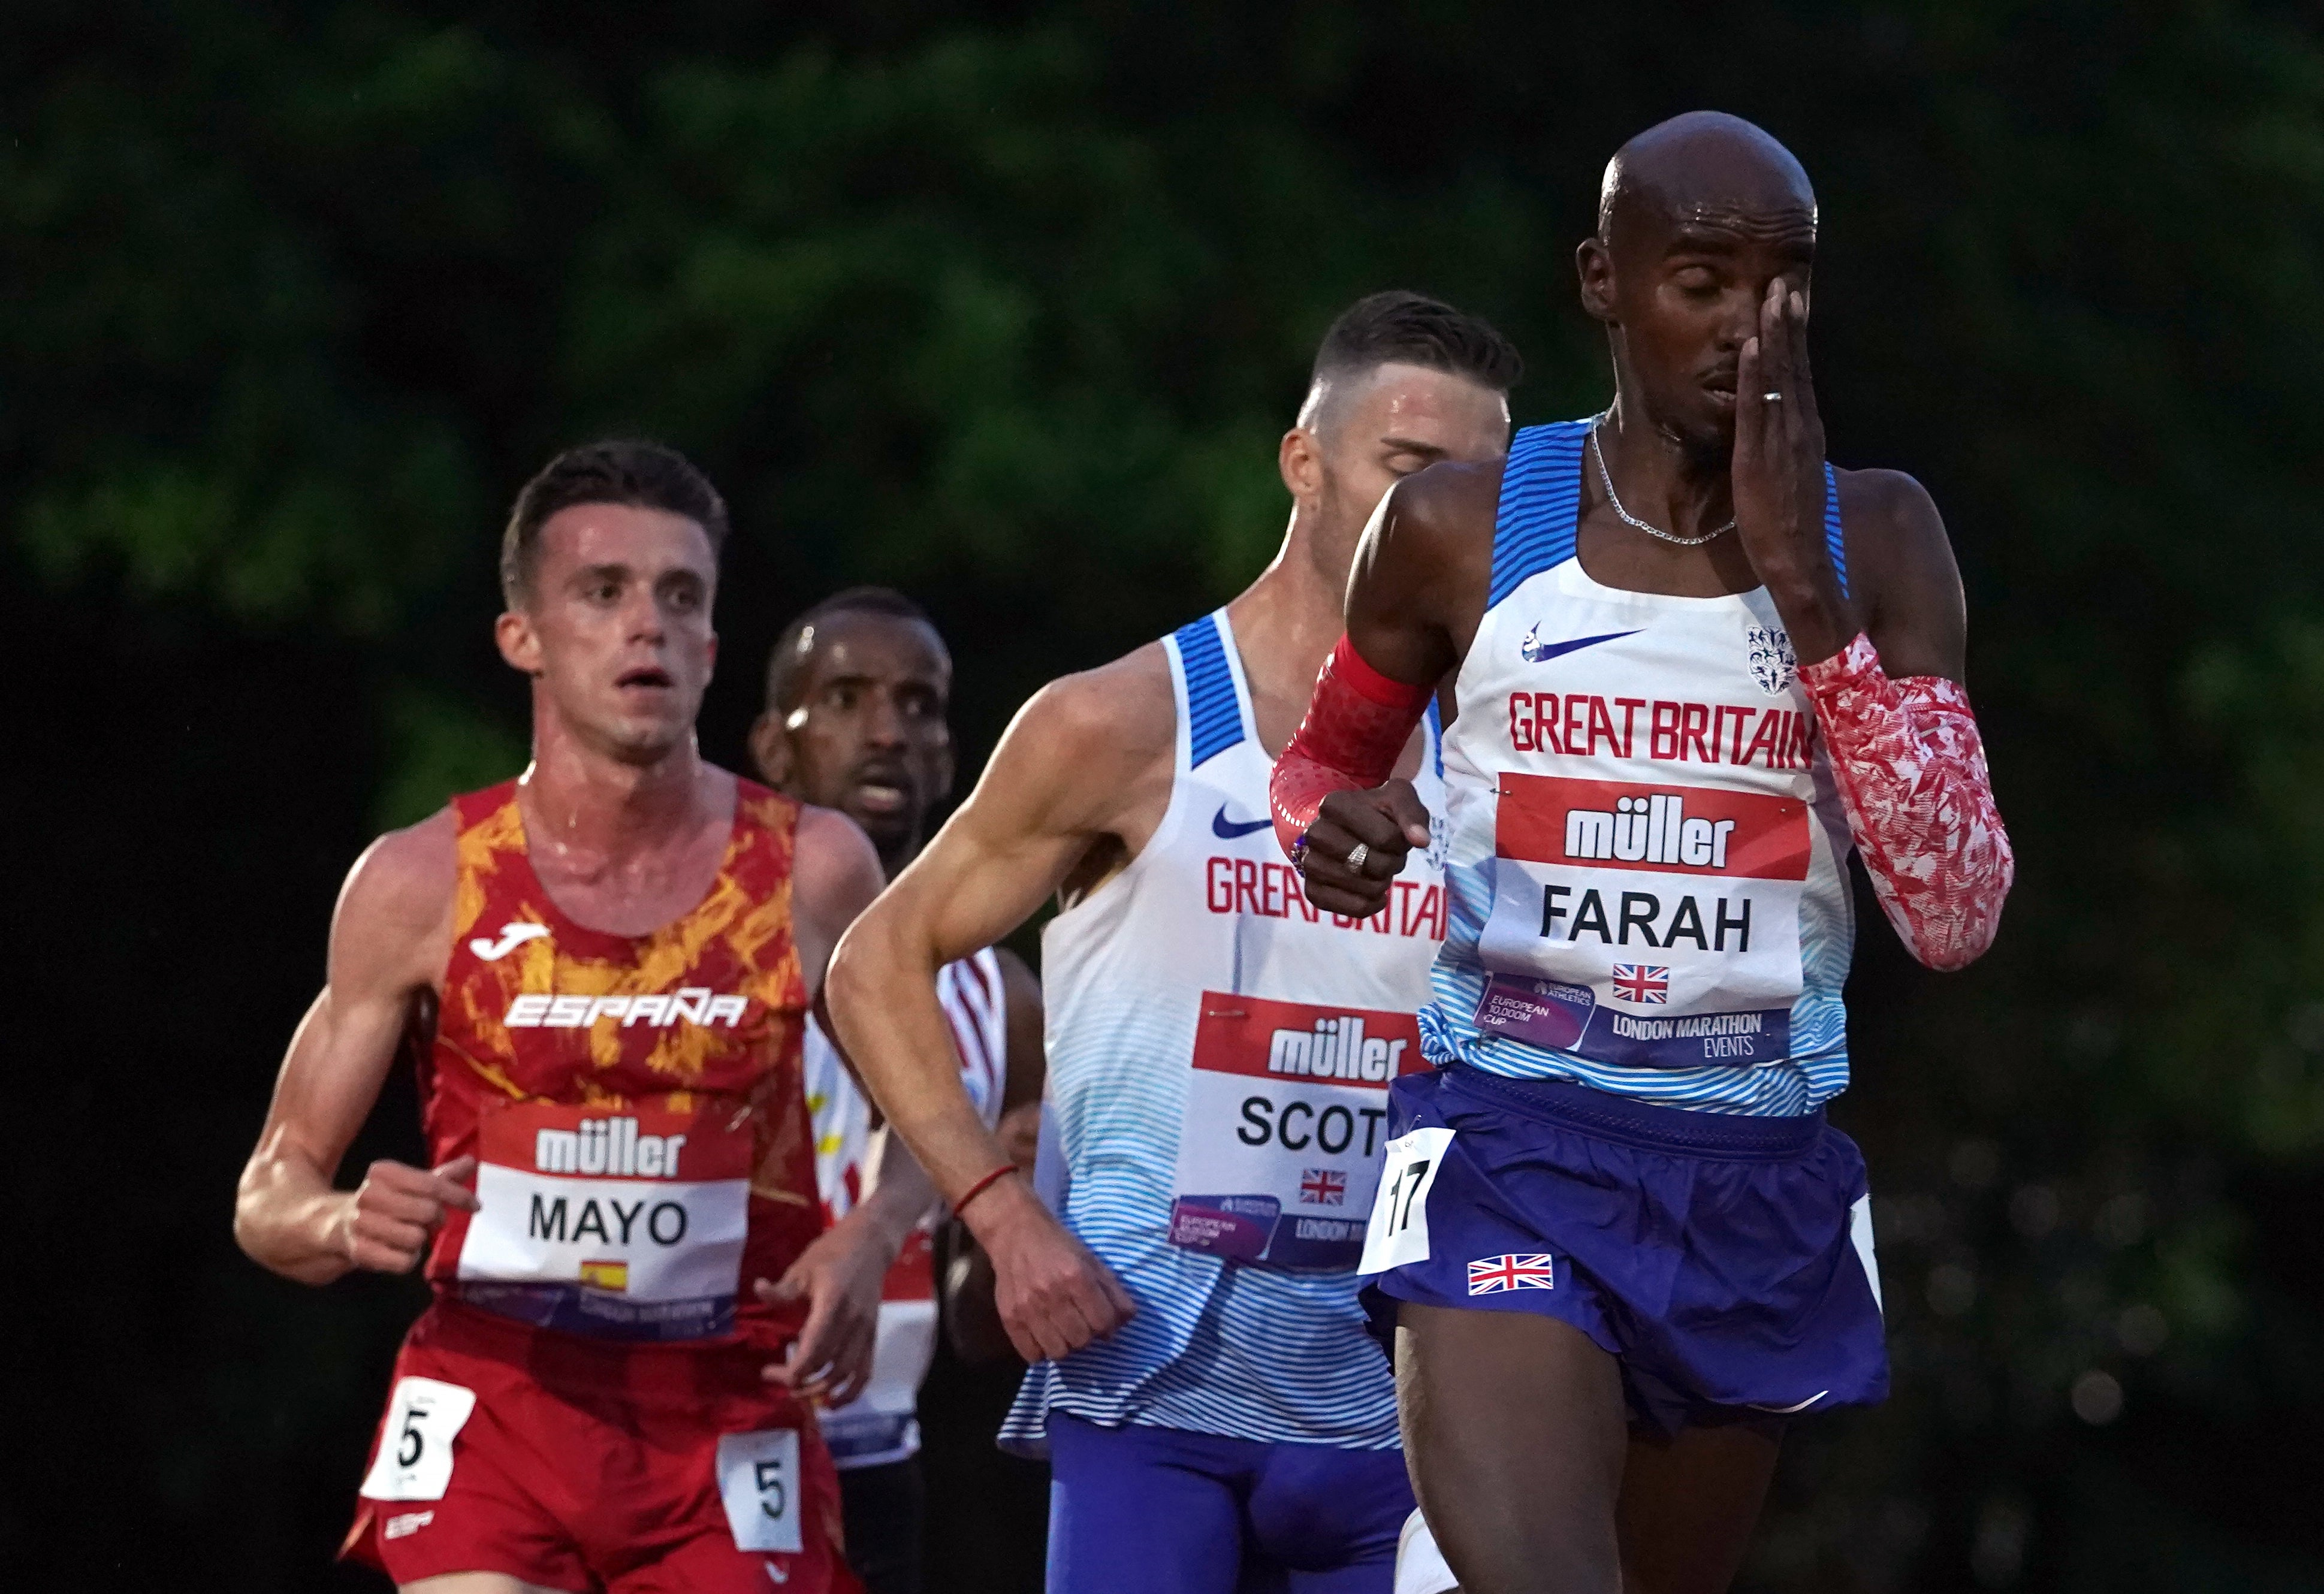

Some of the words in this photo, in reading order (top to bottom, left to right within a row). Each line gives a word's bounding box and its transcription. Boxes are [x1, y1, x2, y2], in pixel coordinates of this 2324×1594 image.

[1510, 692, 1646, 759] GREAT
[1651, 701, 1819, 769] BRITAIN
[1565, 794, 1735, 868] müller
[1206, 856, 1318, 923] GREA
[1540, 884, 1751, 952] FARAH
[503, 986, 748, 1027] ESPAÑA
[1483, 1014, 1507, 1026] CUP
[1492, 995, 1550, 1017] EUROPEAN
[1612, 1014, 1674, 1041] LONDON
[1676, 1013, 1762, 1038] MARATHON
[1267, 1016, 1408, 1082] müller
[1704, 1035, 1755, 1058] EVENTS
[535, 1116, 687, 1179] müller
[1236, 1095, 1387, 1158] SCOT
[529, 1191, 687, 1246] MAYO
[1387, 1159, 1431, 1237] 17
[397, 1409, 429, 1466] 5
[755, 1461, 786, 1520] 5
